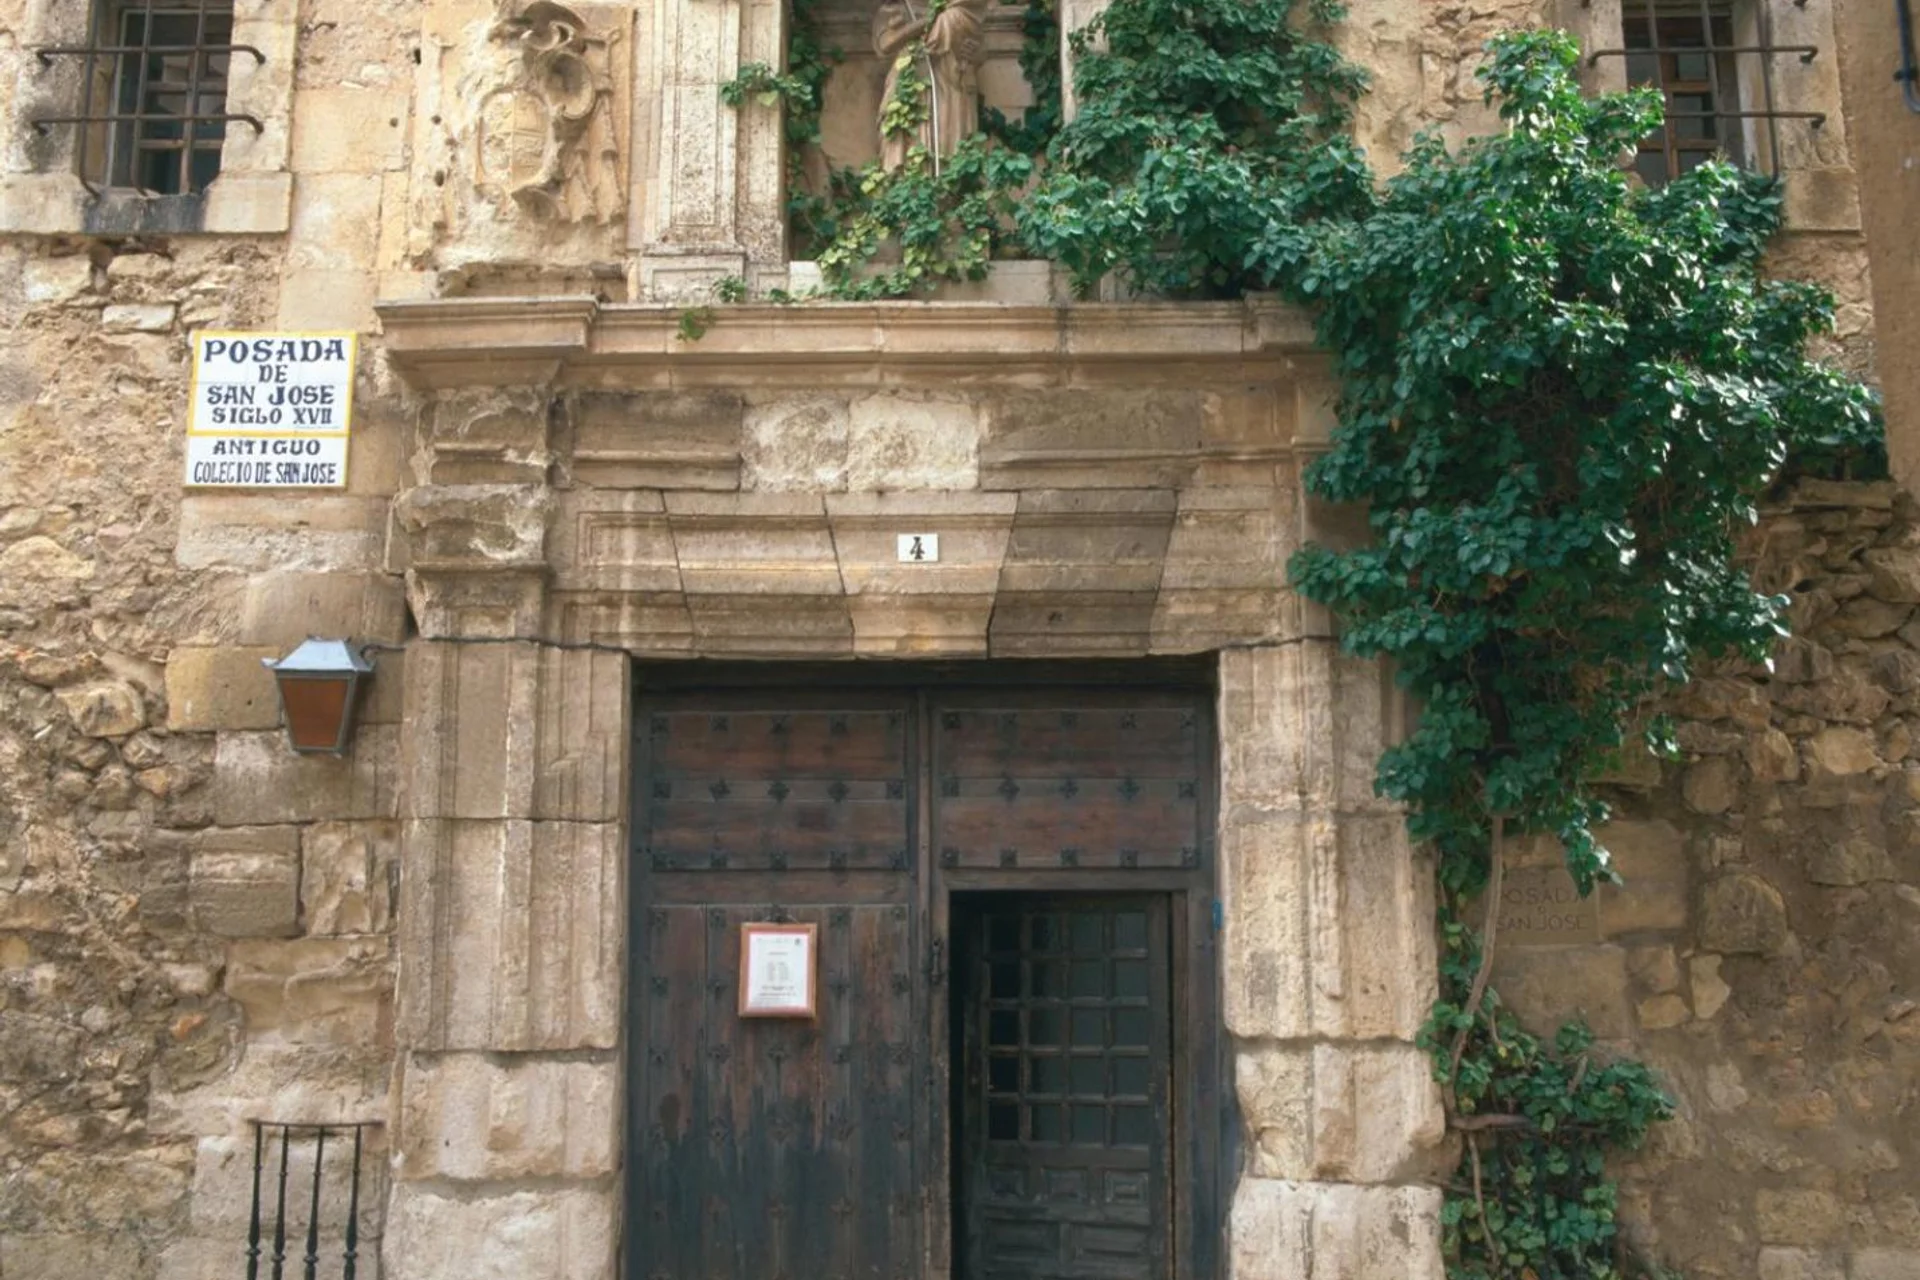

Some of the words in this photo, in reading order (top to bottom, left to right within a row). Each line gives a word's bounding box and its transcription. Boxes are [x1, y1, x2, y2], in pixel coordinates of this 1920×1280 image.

[204, 339, 345, 363] POSADA
[258, 364, 288, 383] DE
[207, 385, 255, 405] SAN
[268, 385, 335, 406] JOSE
[212, 407, 282, 425] SIGLO
[293, 407, 332, 425] XVII
[213, 439, 321, 456] ANTIGUO
[255, 462, 272, 484] DE
[276, 462, 300, 484] SAN
[302, 462, 336, 484] JOSE
[909, 536, 925, 560] 4
[1534, 914, 1589, 931] JOSE
